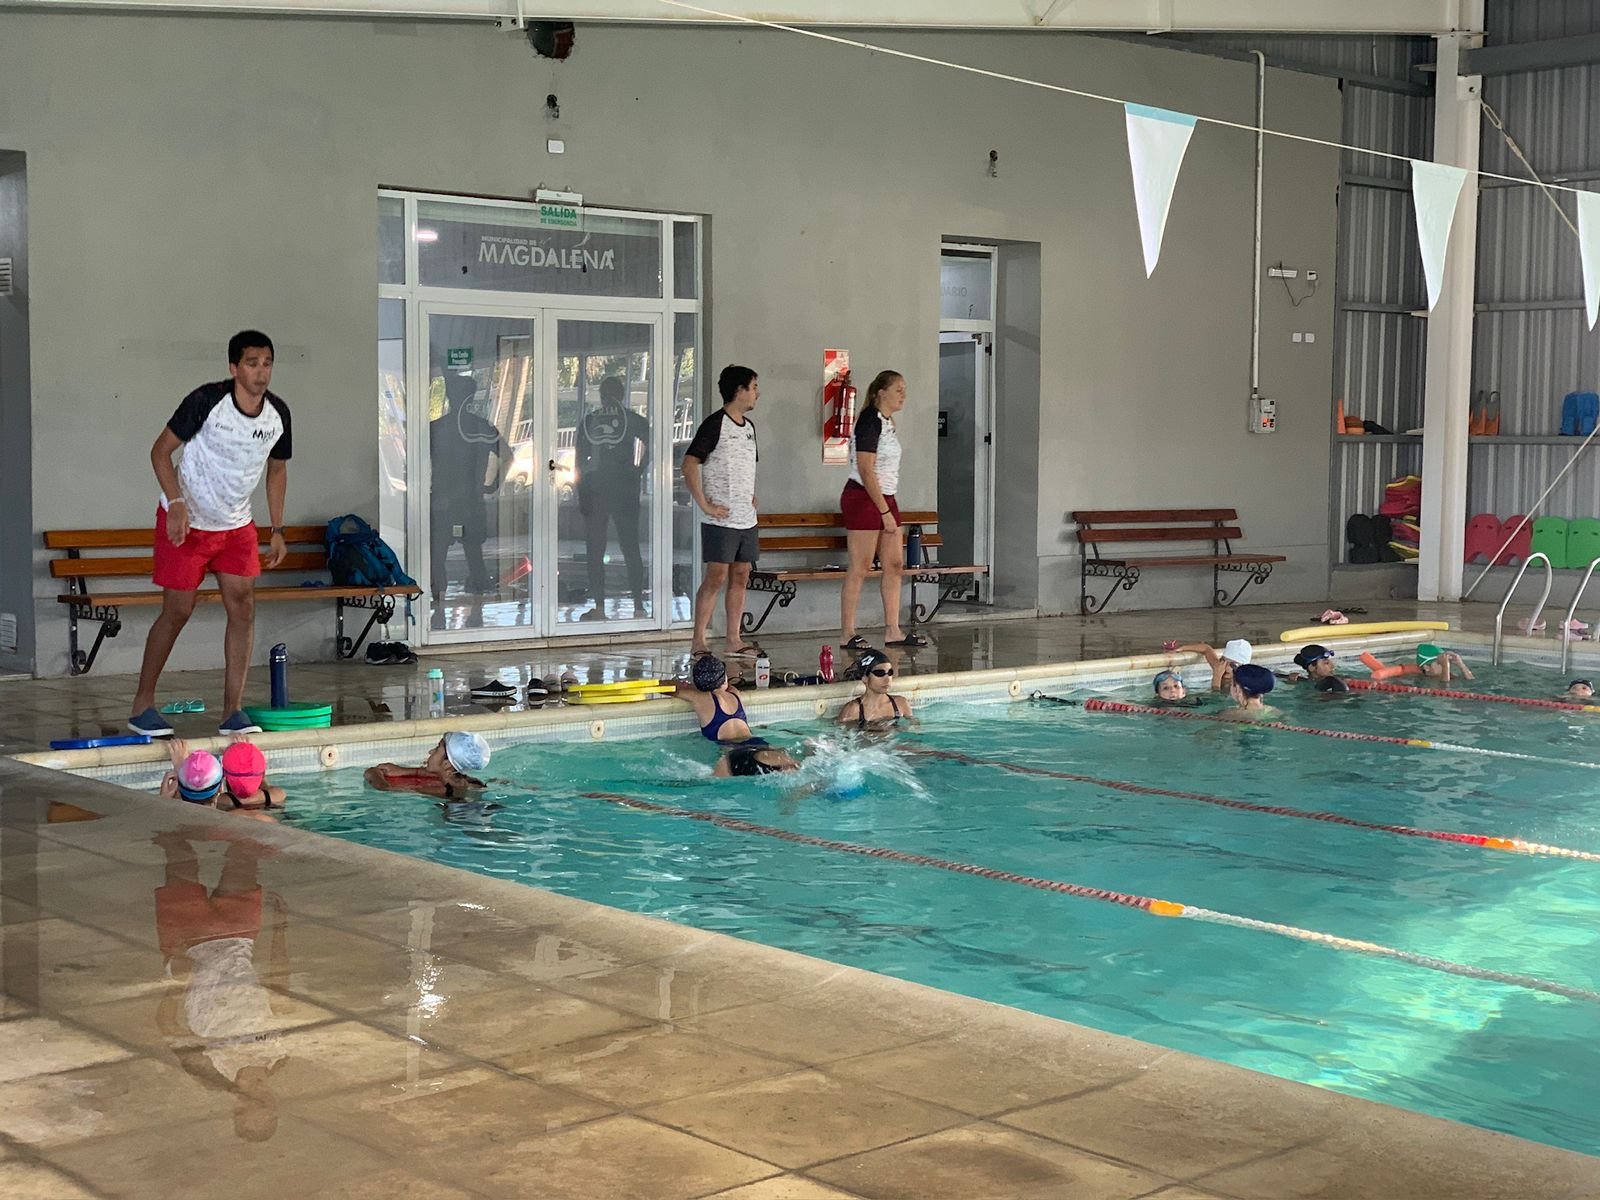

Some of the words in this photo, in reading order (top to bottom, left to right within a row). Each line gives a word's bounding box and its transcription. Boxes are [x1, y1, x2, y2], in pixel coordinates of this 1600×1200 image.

[540, 206, 577, 219] SALIDA
[481, 236, 528, 245] MUNICIPALIDAD
[479, 242, 614, 269] MAGDALENA
